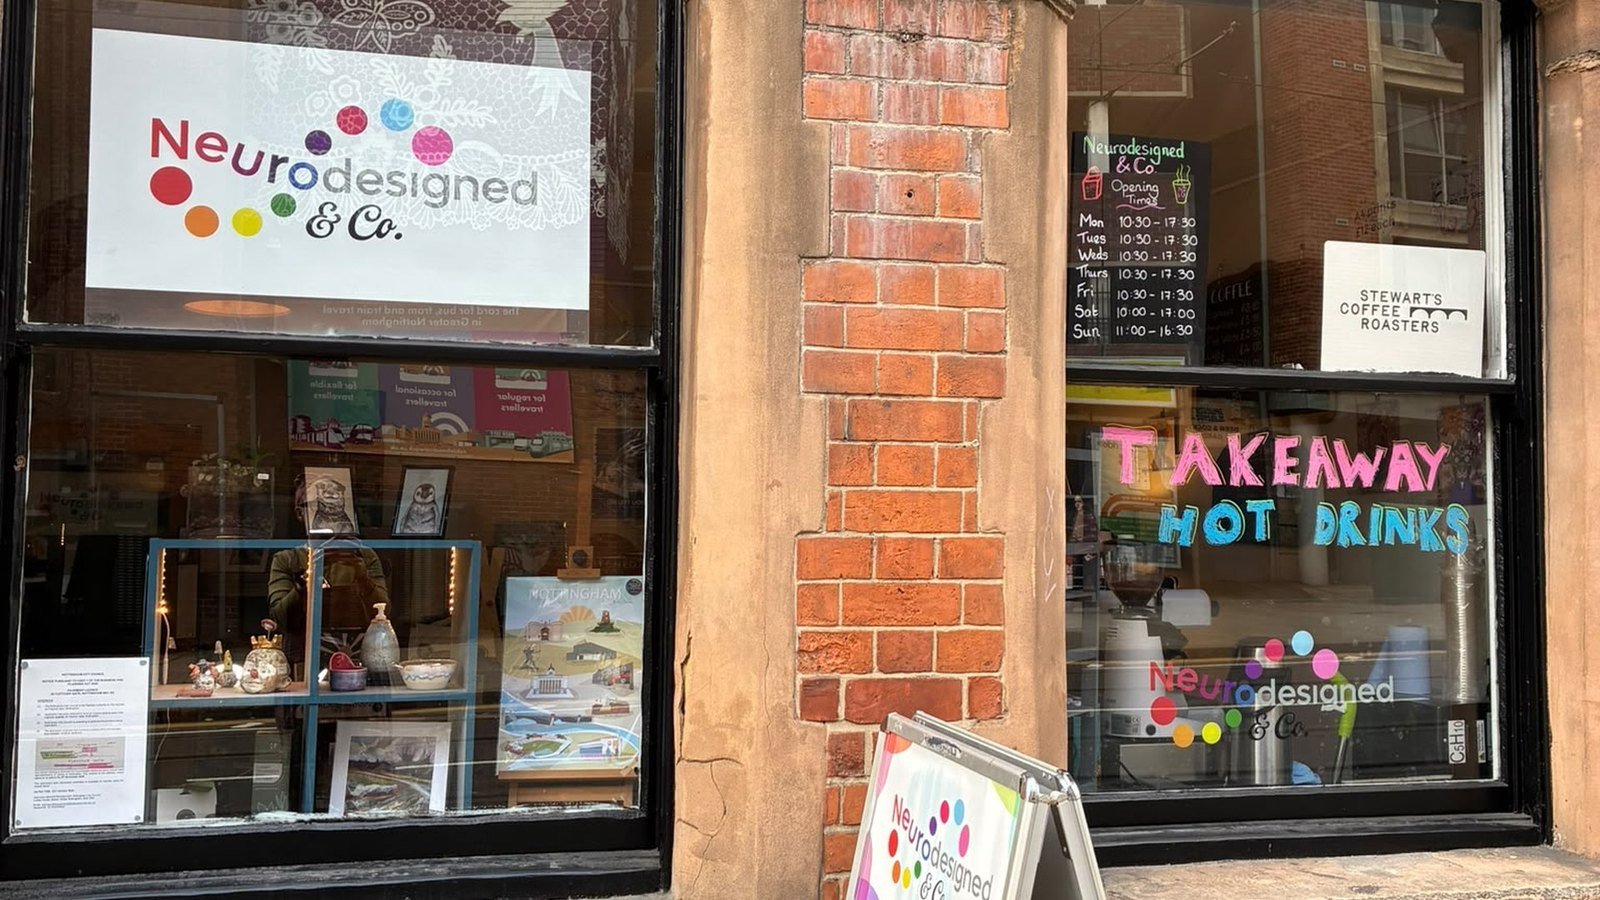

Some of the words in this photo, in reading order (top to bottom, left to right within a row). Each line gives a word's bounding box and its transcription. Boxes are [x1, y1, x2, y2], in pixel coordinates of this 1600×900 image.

[1083, 135, 1184, 165] Neurodesigned
[150, 117, 538, 208] Neurodesigned
[1116, 155, 1131, 174] &
[1133, 156, 1157, 175] Co.
[1111, 179, 1159, 199] Opening
[1125, 194, 1158, 206] Times
[305, 201, 341, 239] &
[347, 204, 404, 241] Co.
[1079, 213, 1104, 228] Mon
[1164, 217, 1196, 228] 17:30
[1076, 231, 1107, 244] Tues
[1164, 235, 1198, 246] 17:30
[1078, 246, 1109, 261] Weds
[1162, 250, 1197, 263] 17:30
[1075, 263, 1109, 279] Thurs
[1119, 268, 1148, 281] 10:30
[1076, 281, 1095, 299] Fri
[1117, 289, 1147, 301] 10:30
[1160, 288, 1194, 301] 17:30
[1359, 289, 1443, 306] STEWART'S
[1074, 303, 1099, 318] Sat
[1117, 306, 1147, 319] 10:00
[1160, 307, 1196, 320] 17:00
[1339, 302, 1401, 318] COFFEE
[1072, 323, 1101, 339] Sun
[1116, 325, 1146, 337] 11:00
[1160, 324, 1194, 338] 16:30
[1360, 317, 1440, 334] ROASTERS
[1101, 423, 1451, 492] TAKEAWAY
[1158, 499, 1275, 547] HOT
[1314, 502, 1470, 555] DRINKS
[528, 586, 623, 601] NOTTINGHAM
[1149, 661, 1394, 713] Neurodesigned
[892, 794, 993, 900] Neurodesigned
